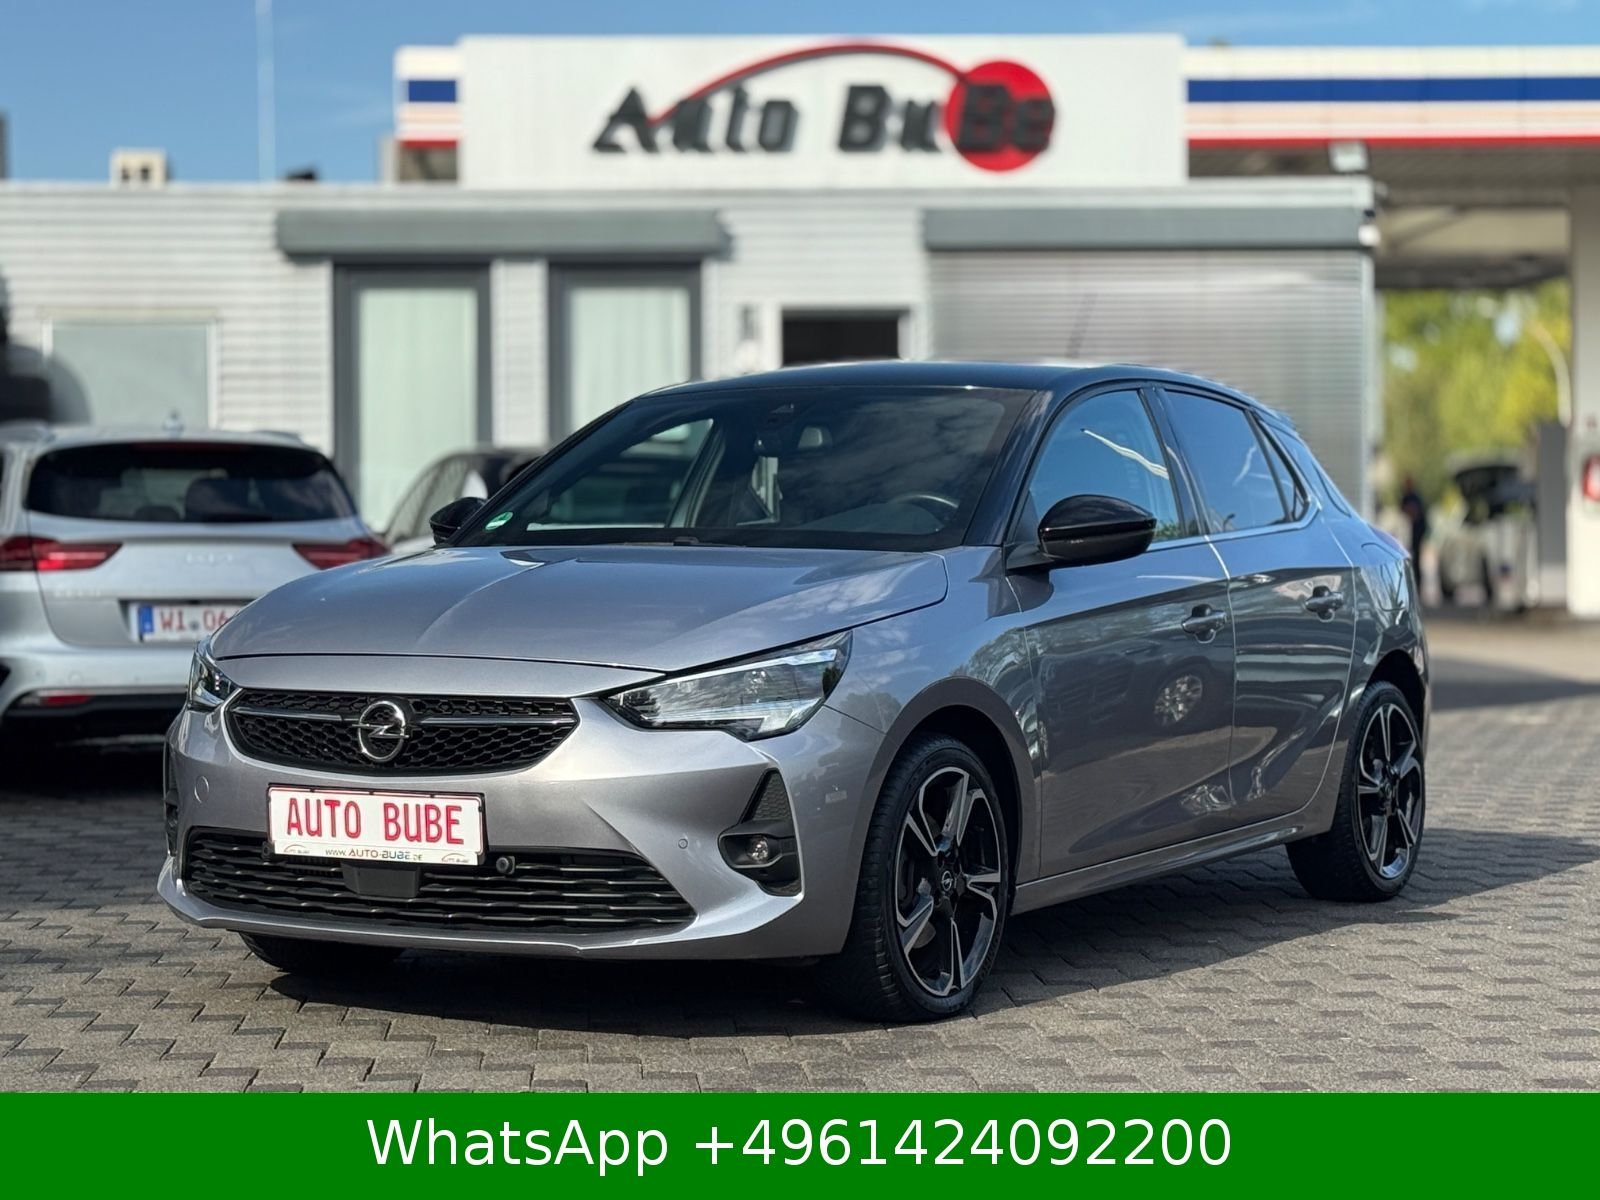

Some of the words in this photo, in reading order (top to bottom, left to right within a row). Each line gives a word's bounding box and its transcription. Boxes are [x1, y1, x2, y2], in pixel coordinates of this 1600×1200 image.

[592, 85, 797, 154] Auto
[838, 84, 1055, 154] BuBe
[159, 608, 185, 632] WI
[286, 797, 362, 839] AUTO
[383, 802, 465, 845] BUBE
